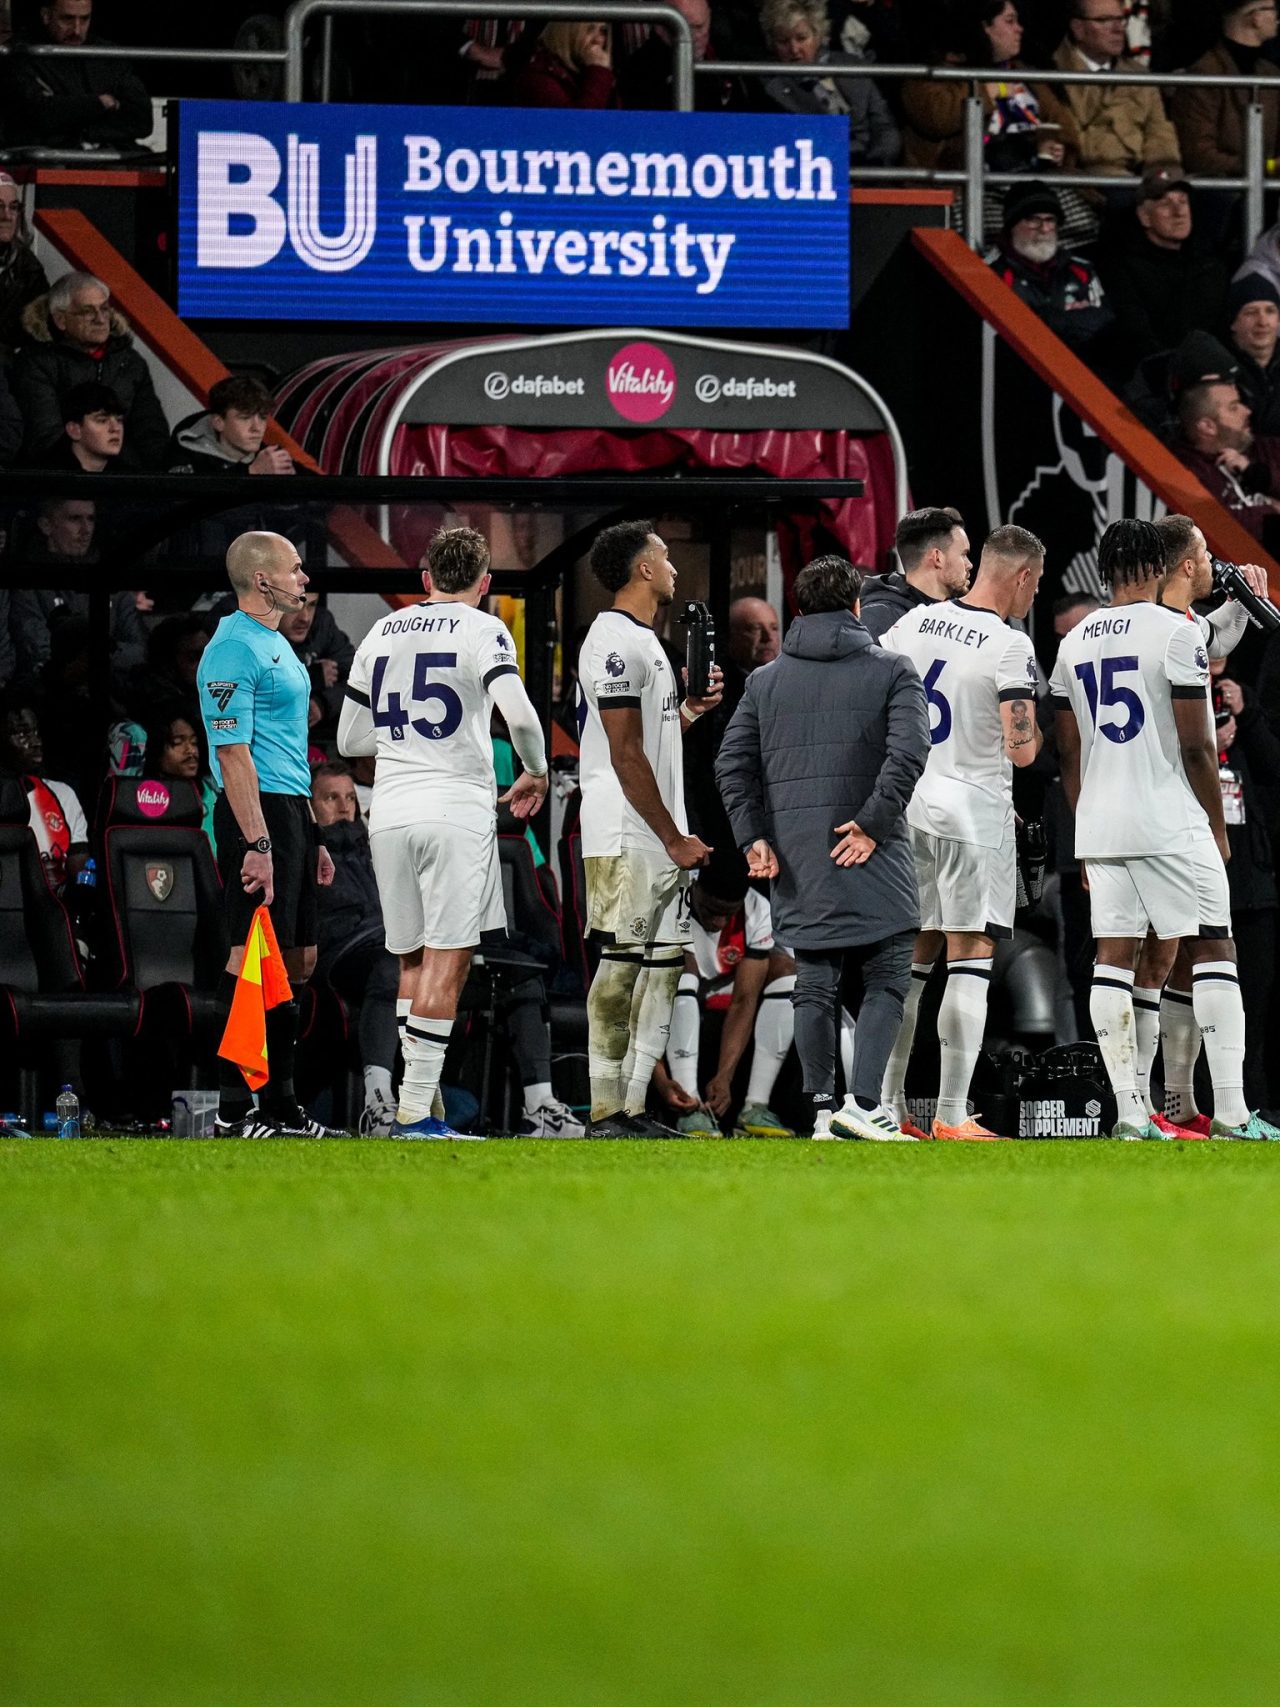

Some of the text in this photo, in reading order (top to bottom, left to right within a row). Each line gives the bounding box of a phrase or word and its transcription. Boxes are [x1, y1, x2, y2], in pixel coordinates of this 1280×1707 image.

[403, 134, 837, 201] Bournemouth
[197, 131, 376, 272] BU
[403, 211, 736, 294] University
[511, 374, 584, 398] dafabet
[608, 361, 675, 404] Vitality
[722, 377, 797, 401] dafabet
[381, 617, 460, 637] DOUGHTY
[918, 618, 989, 649] BARKLEY
[1083, 619, 1131, 640] MENGI
[371, 652, 463, 741] 45
[1074, 655, 1145, 744] 15
[137, 788, 170, 809] Vitality
[1019, 1100, 1065, 1118] SOCCER
[1019, 1118, 1101, 1137] SUPPLEMENT
